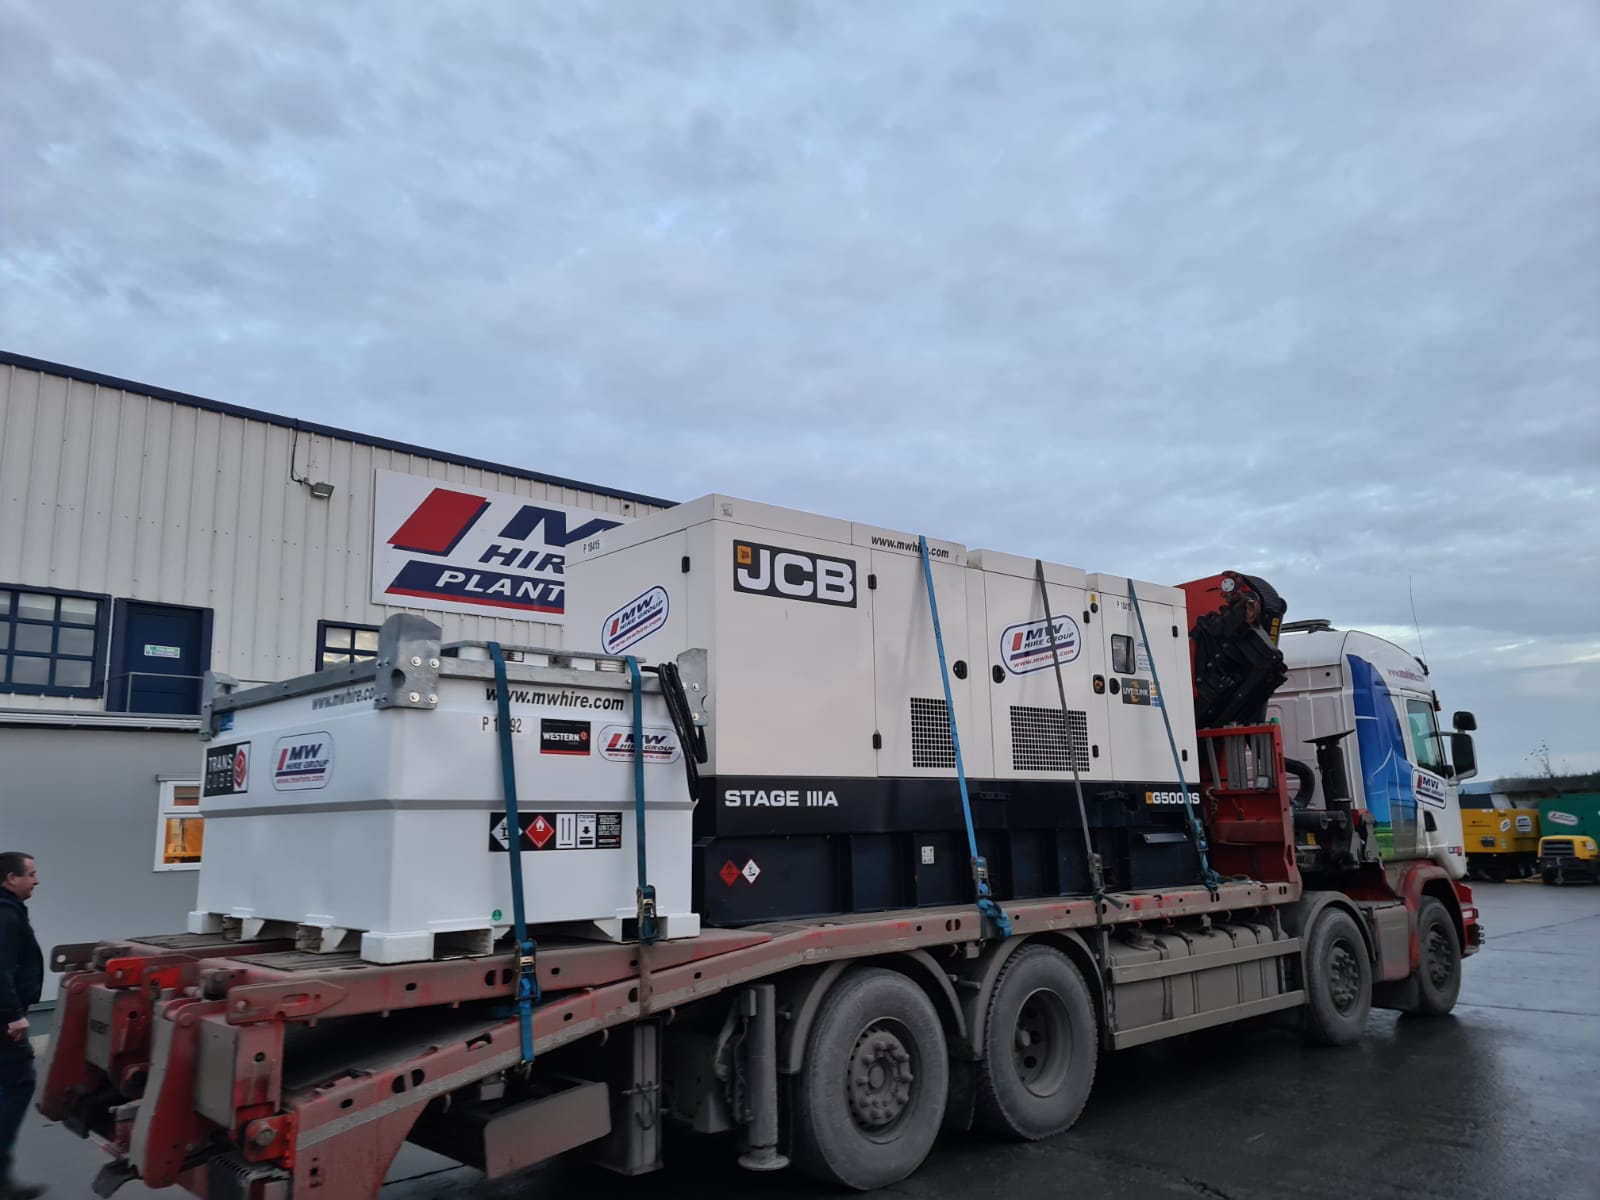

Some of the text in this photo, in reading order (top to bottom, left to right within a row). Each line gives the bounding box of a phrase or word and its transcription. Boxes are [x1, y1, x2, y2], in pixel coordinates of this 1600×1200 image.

[871, 536, 950, 558] www.mwhi.com
[478, 544, 566, 575] HIR
[737, 548, 855, 603] JCB
[435, 570, 566, 602] PLANT
[620, 595, 655, 624] MW
[1025, 623, 1064, 641] MW
[1024, 638, 1044, 649] HIRE
[485, 687, 625, 711] ww.mwhire.com
[482, 716, 522, 733] P 192
[542, 731, 580, 742] WESTERN
[288, 743, 323, 761] MW
[208, 753, 233, 772] TRANS
[724, 790, 839, 807] STAGE IIIA
